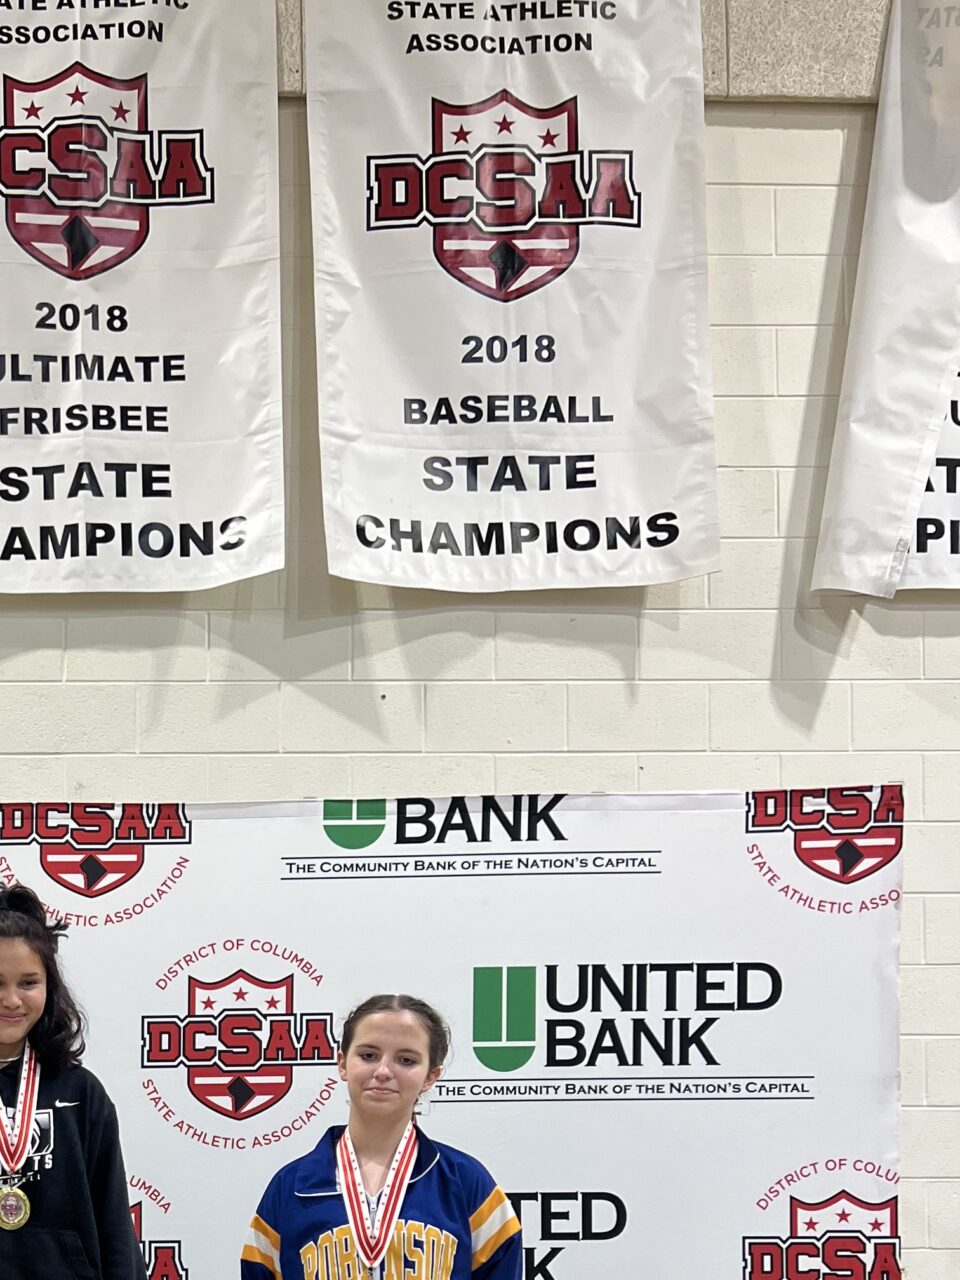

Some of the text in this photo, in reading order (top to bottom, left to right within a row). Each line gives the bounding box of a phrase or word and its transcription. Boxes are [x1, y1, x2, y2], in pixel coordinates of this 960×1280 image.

[388, 0, 617, 21] STATE ATHLETIC
[406, 33, 592, 55] ASSOCIATION
[366, 143, 641, 233] DCSAA
[36, 303, 127, 332] 2018
[462, 335, 555, 363] 2018
[0, 404, 168, 435] FRISBEE
[404, 395, 613, 424] BASEBALL
[424, 455, 596, 491] STATE
[356, 512, 679, 555] CHAMPIONS
[395, 794, 568, 844] BANK
[746, 784, 904, 834] DCSA
[286, 857, 656, 873] THE COMMUNITY BANK OF THE NATION'S CAPITAL
[747, 844, 779, 886] STATE
[779, 885, 851, 914] ATHLETIC
[156, 939, 323, 990] DISTRICT OF COLUMBIA
[545, 962, 782, 1012] UNITED
[141, 1008, 340, 1072] DCSAA
[545, 1018, 720, 1067] BANK
[436, 1082, 809, 1095] THE COMMUNITY BANK OF THE NATION'S CAPITAL
[144, 1079, 337, 1150] STATE ATHLETIC ASSOCIATION
[756, 1158, 846, 1210] DISTRICT OF
